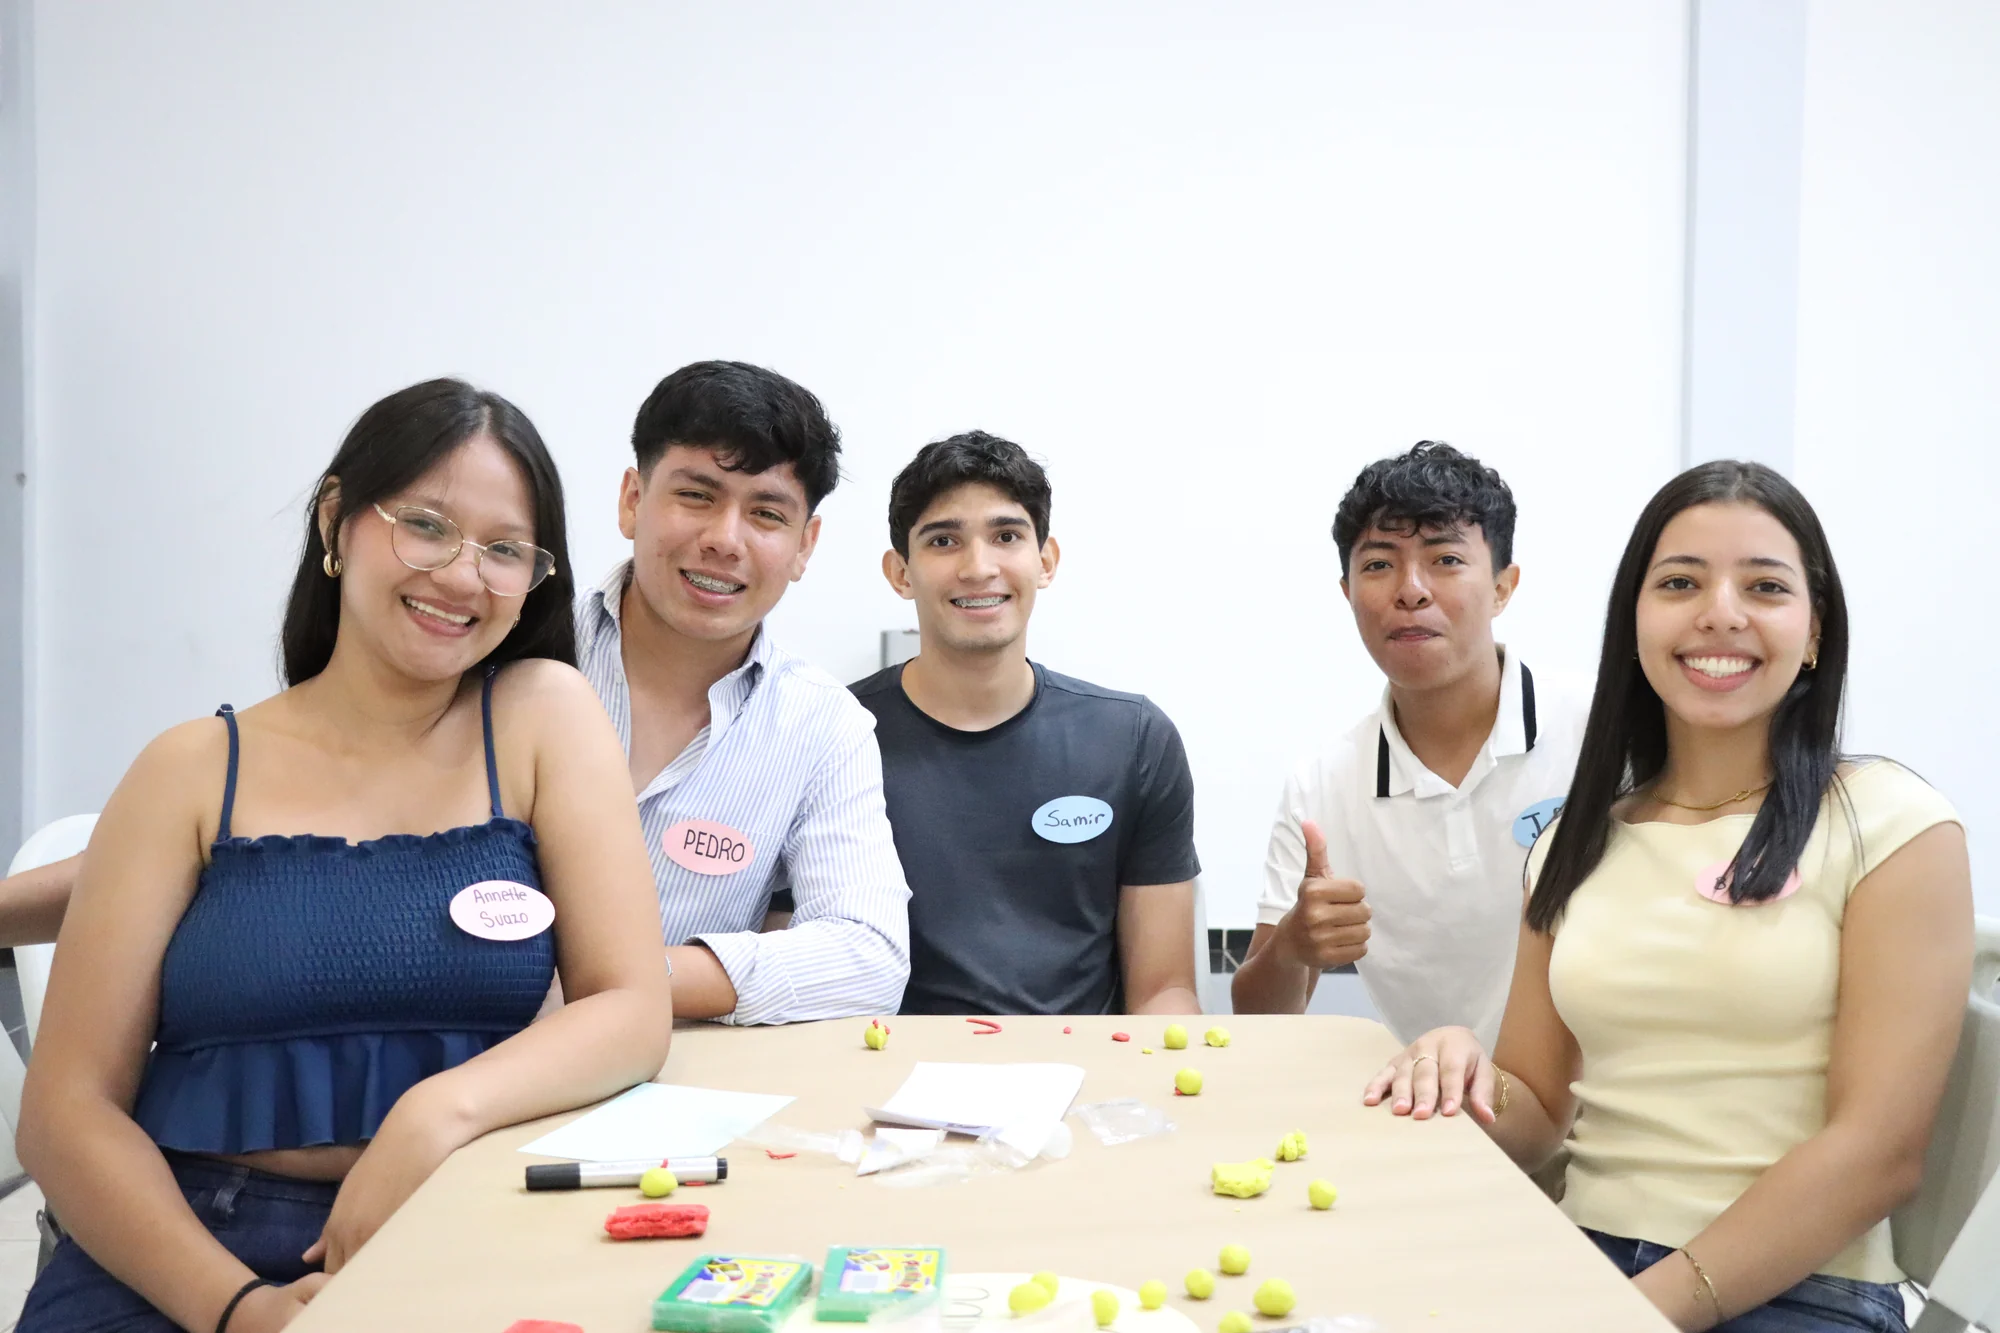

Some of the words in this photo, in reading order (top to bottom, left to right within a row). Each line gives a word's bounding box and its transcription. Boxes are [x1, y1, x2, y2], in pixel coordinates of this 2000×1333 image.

[1043, 809, 1105, 828] Samir
[683, 829, 745, 862] PEDRO
[473, 886, 527, 904] Annette
[479, 911, 529, 928] Suazo
